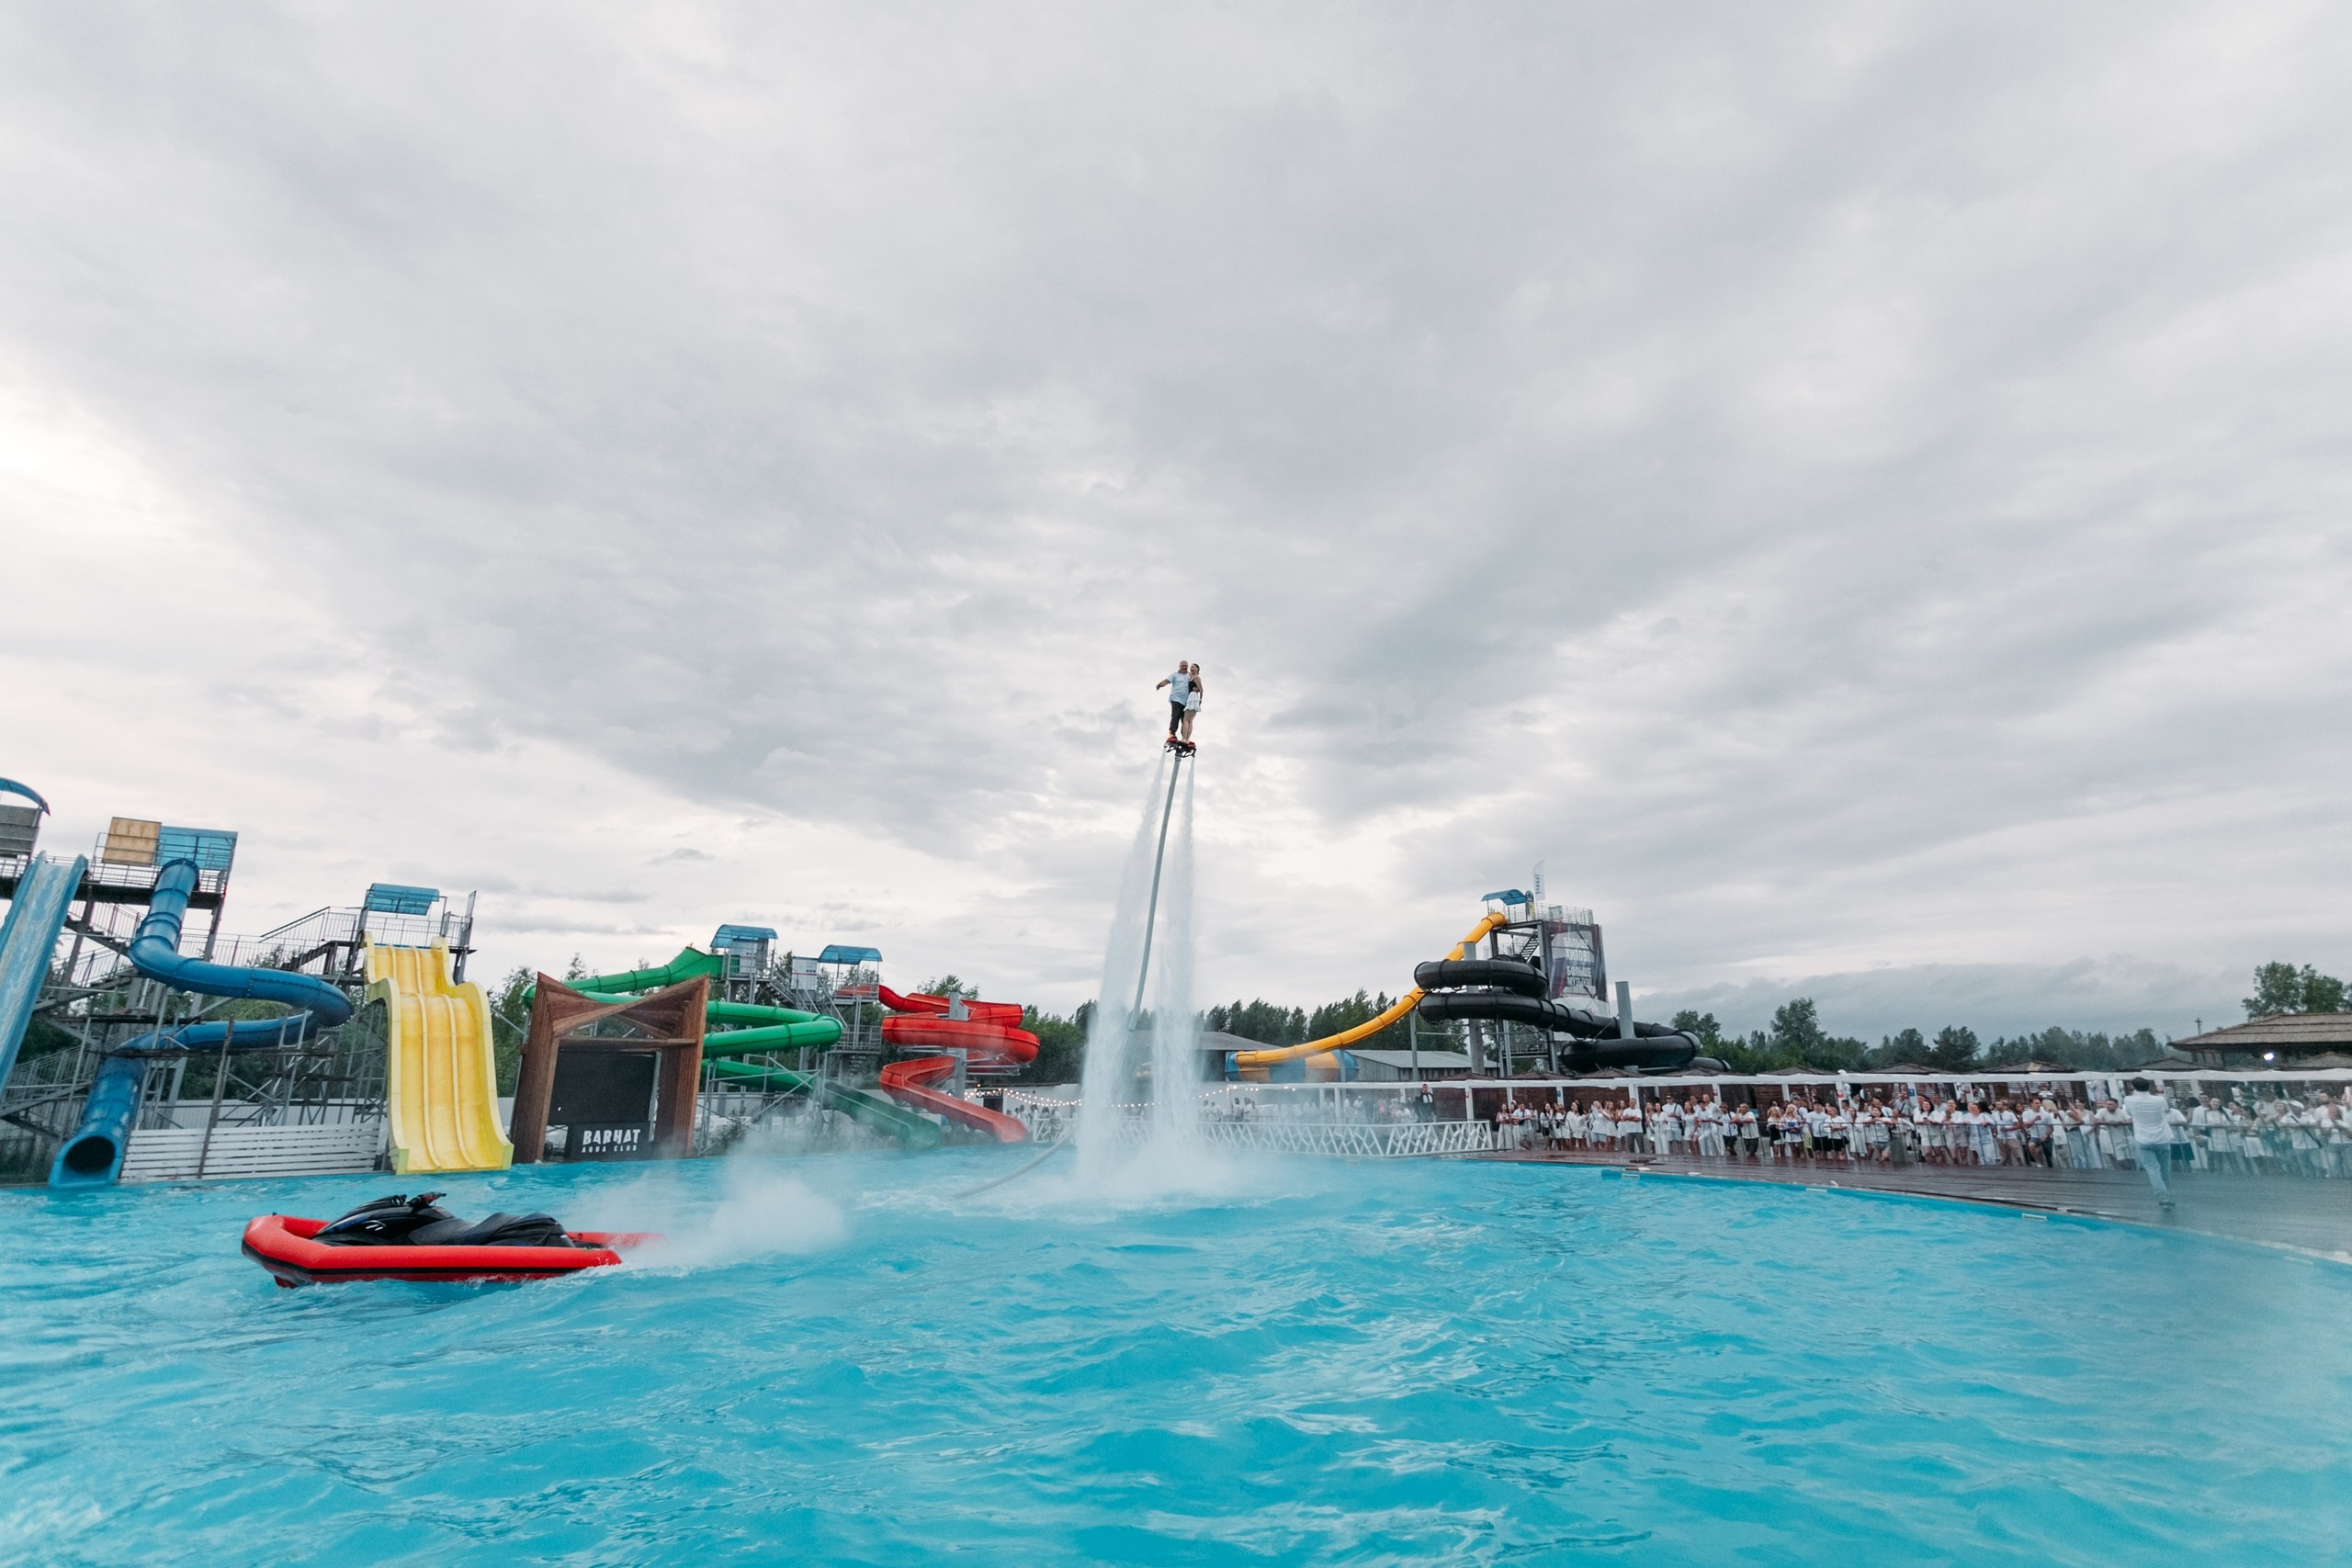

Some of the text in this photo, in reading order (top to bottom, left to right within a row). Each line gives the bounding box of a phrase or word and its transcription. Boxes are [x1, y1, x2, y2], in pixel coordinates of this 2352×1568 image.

[1564, 937, 1589, 949] БОЛЬШЕ
[1566, 965, 1591, 977] БОЛЬШЕ
[582, 1129, 641, 1145] BARHAT
